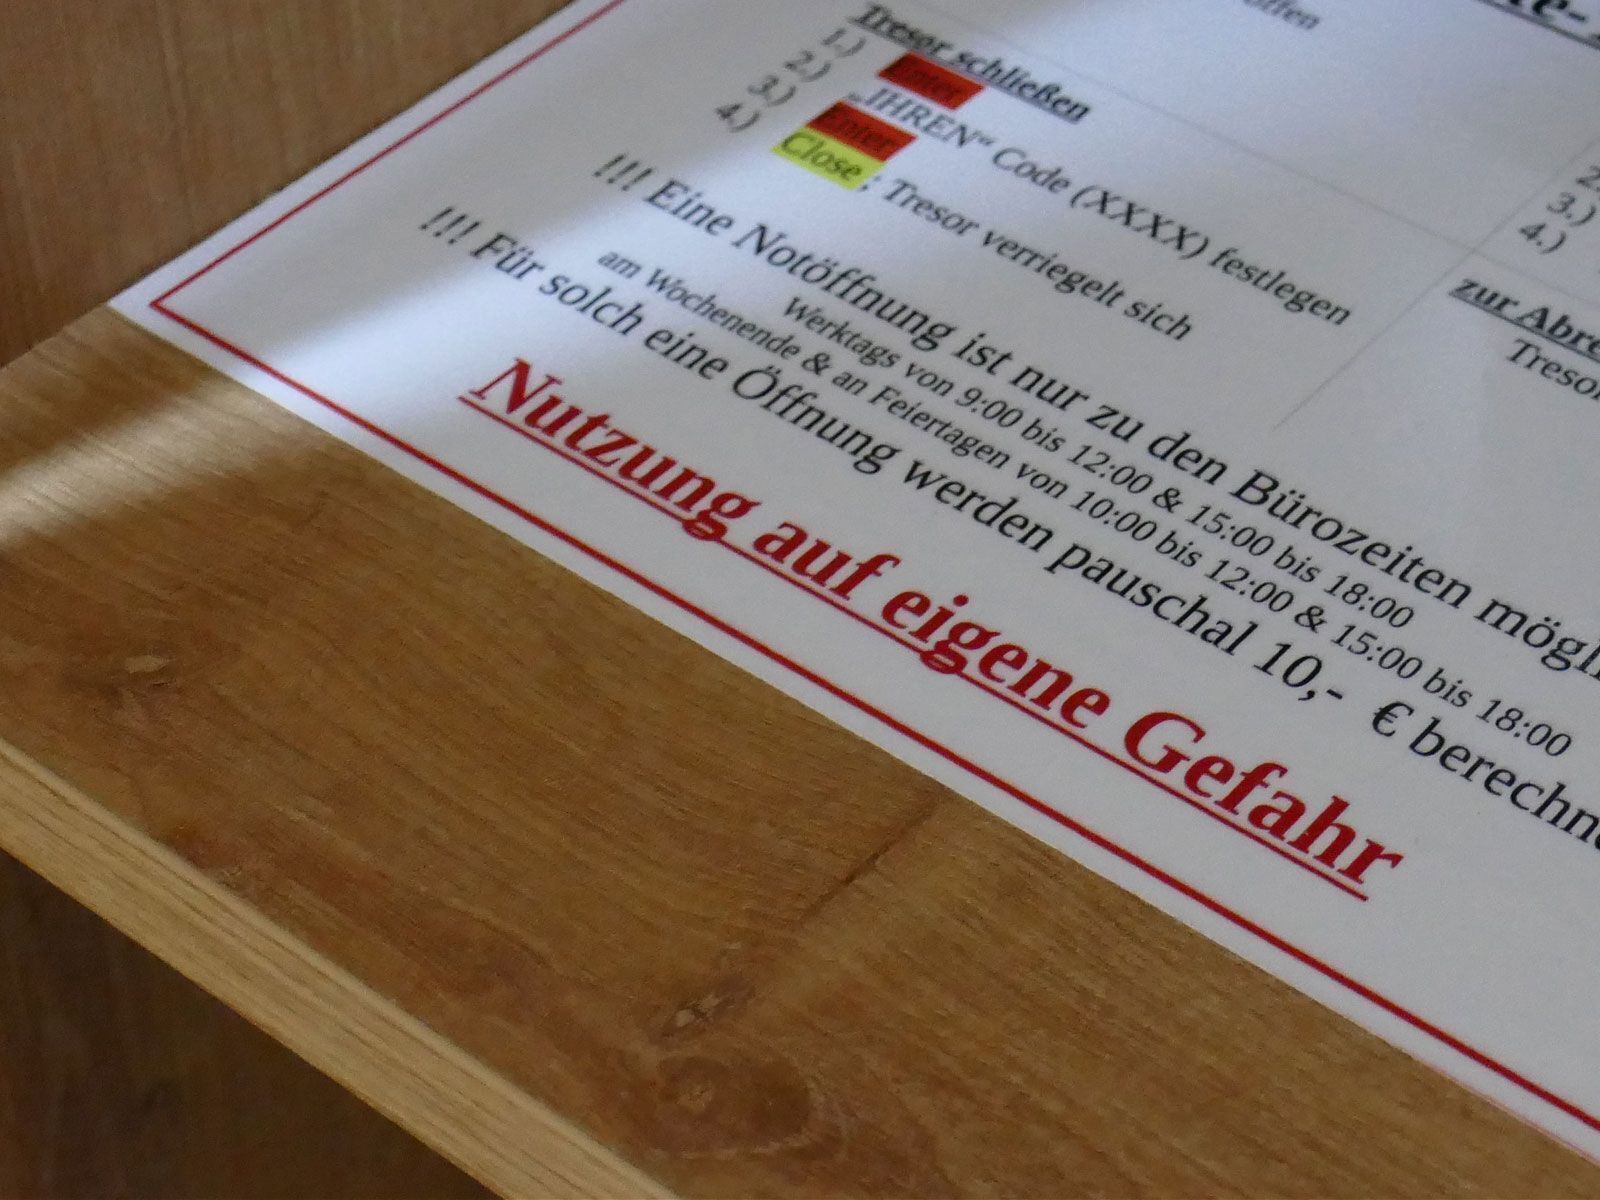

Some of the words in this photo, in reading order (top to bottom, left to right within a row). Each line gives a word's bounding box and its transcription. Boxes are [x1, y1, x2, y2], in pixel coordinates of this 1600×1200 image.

[846, 2, 955, 56] Tresor
[782, 132, 862, 180] Close
[884, 178, 979, 236] Tresor
[982, 230, 1125, 308] verriegelt
[1124, 300, 1192, 341] sich
[992, 146, 1070, 193] Code
[1070, 185, 1209, 259] (XXXX)
[1210, 247, 1351, 325] festlegen
[1450, 278, 1521, 317] zur
[1519, 222, 1566, 254] 4.)
[1547, 191, 1596, 227] 3.)
[419, 207, 482, 245] !!!
[470, 232, 545, 281] Für
[539, 274, 644, 337] solch
[645, 328, 728, 381] eine
[733, 365, 903, 476] Öffnung
[904, 460, 1054, 553] werden
[1045, 542, 1259, 657] pauschal
[1253, 640, 1344, 702] 10,-
[1373, 700, 1414, 737] €
[594, 153, 655, 193] !!!
[645, 178, 733, 237] Eine
[732, 223, 958, 353] Notöffnung
[954, 332, 1014, 376] ist
[1010, 364, 1090, 412] nur
[1087, 402, 1145, 444] zu
[1148, 431, 1229, 486] den
[1230, 468, 1473, 610] Bürozeiten
[783, 295, 900, 368] Werktags
[904, 361, 957, 397] von
[955, 386, 1025, 430] 9:00
[1021, 417, 1067, 454] bis
[1067, 444, 1154, 495] 12:00
[1152, 487, 1186, 514] &
[1187, 504, 1275, 558] 15:00
[1275, 545, 1321, 583] bis
[1323, 574, 1416, 630] 18:00
[598, 250, 642, 280] am
[648, 267, 803, 362] Wochenende
[801, 352, 833, 377] &
[833, 369, 869, 397] an
[868, 385, 1012, 470] Feiertagen
[1016, 462, 1069, 499] von
[1070, 491, 1158, 542] 10:00
[1155, 530, 1203, 569] bis
[1205, 559, 1295, 614] 12:00
[1294, 605, 1328, 633] &
[1332, 624, 1423, 681] 15:00
[1422, 667, 1474, 709] bis
[1476, 699, 1572, 758] 18:00
[470, 357, 763, 541] Nutzung
[752, 519, 902, 601] auf
[880, 588, 1111, 730] eigene
[1122, 710, 1403, 890] Gefahr
